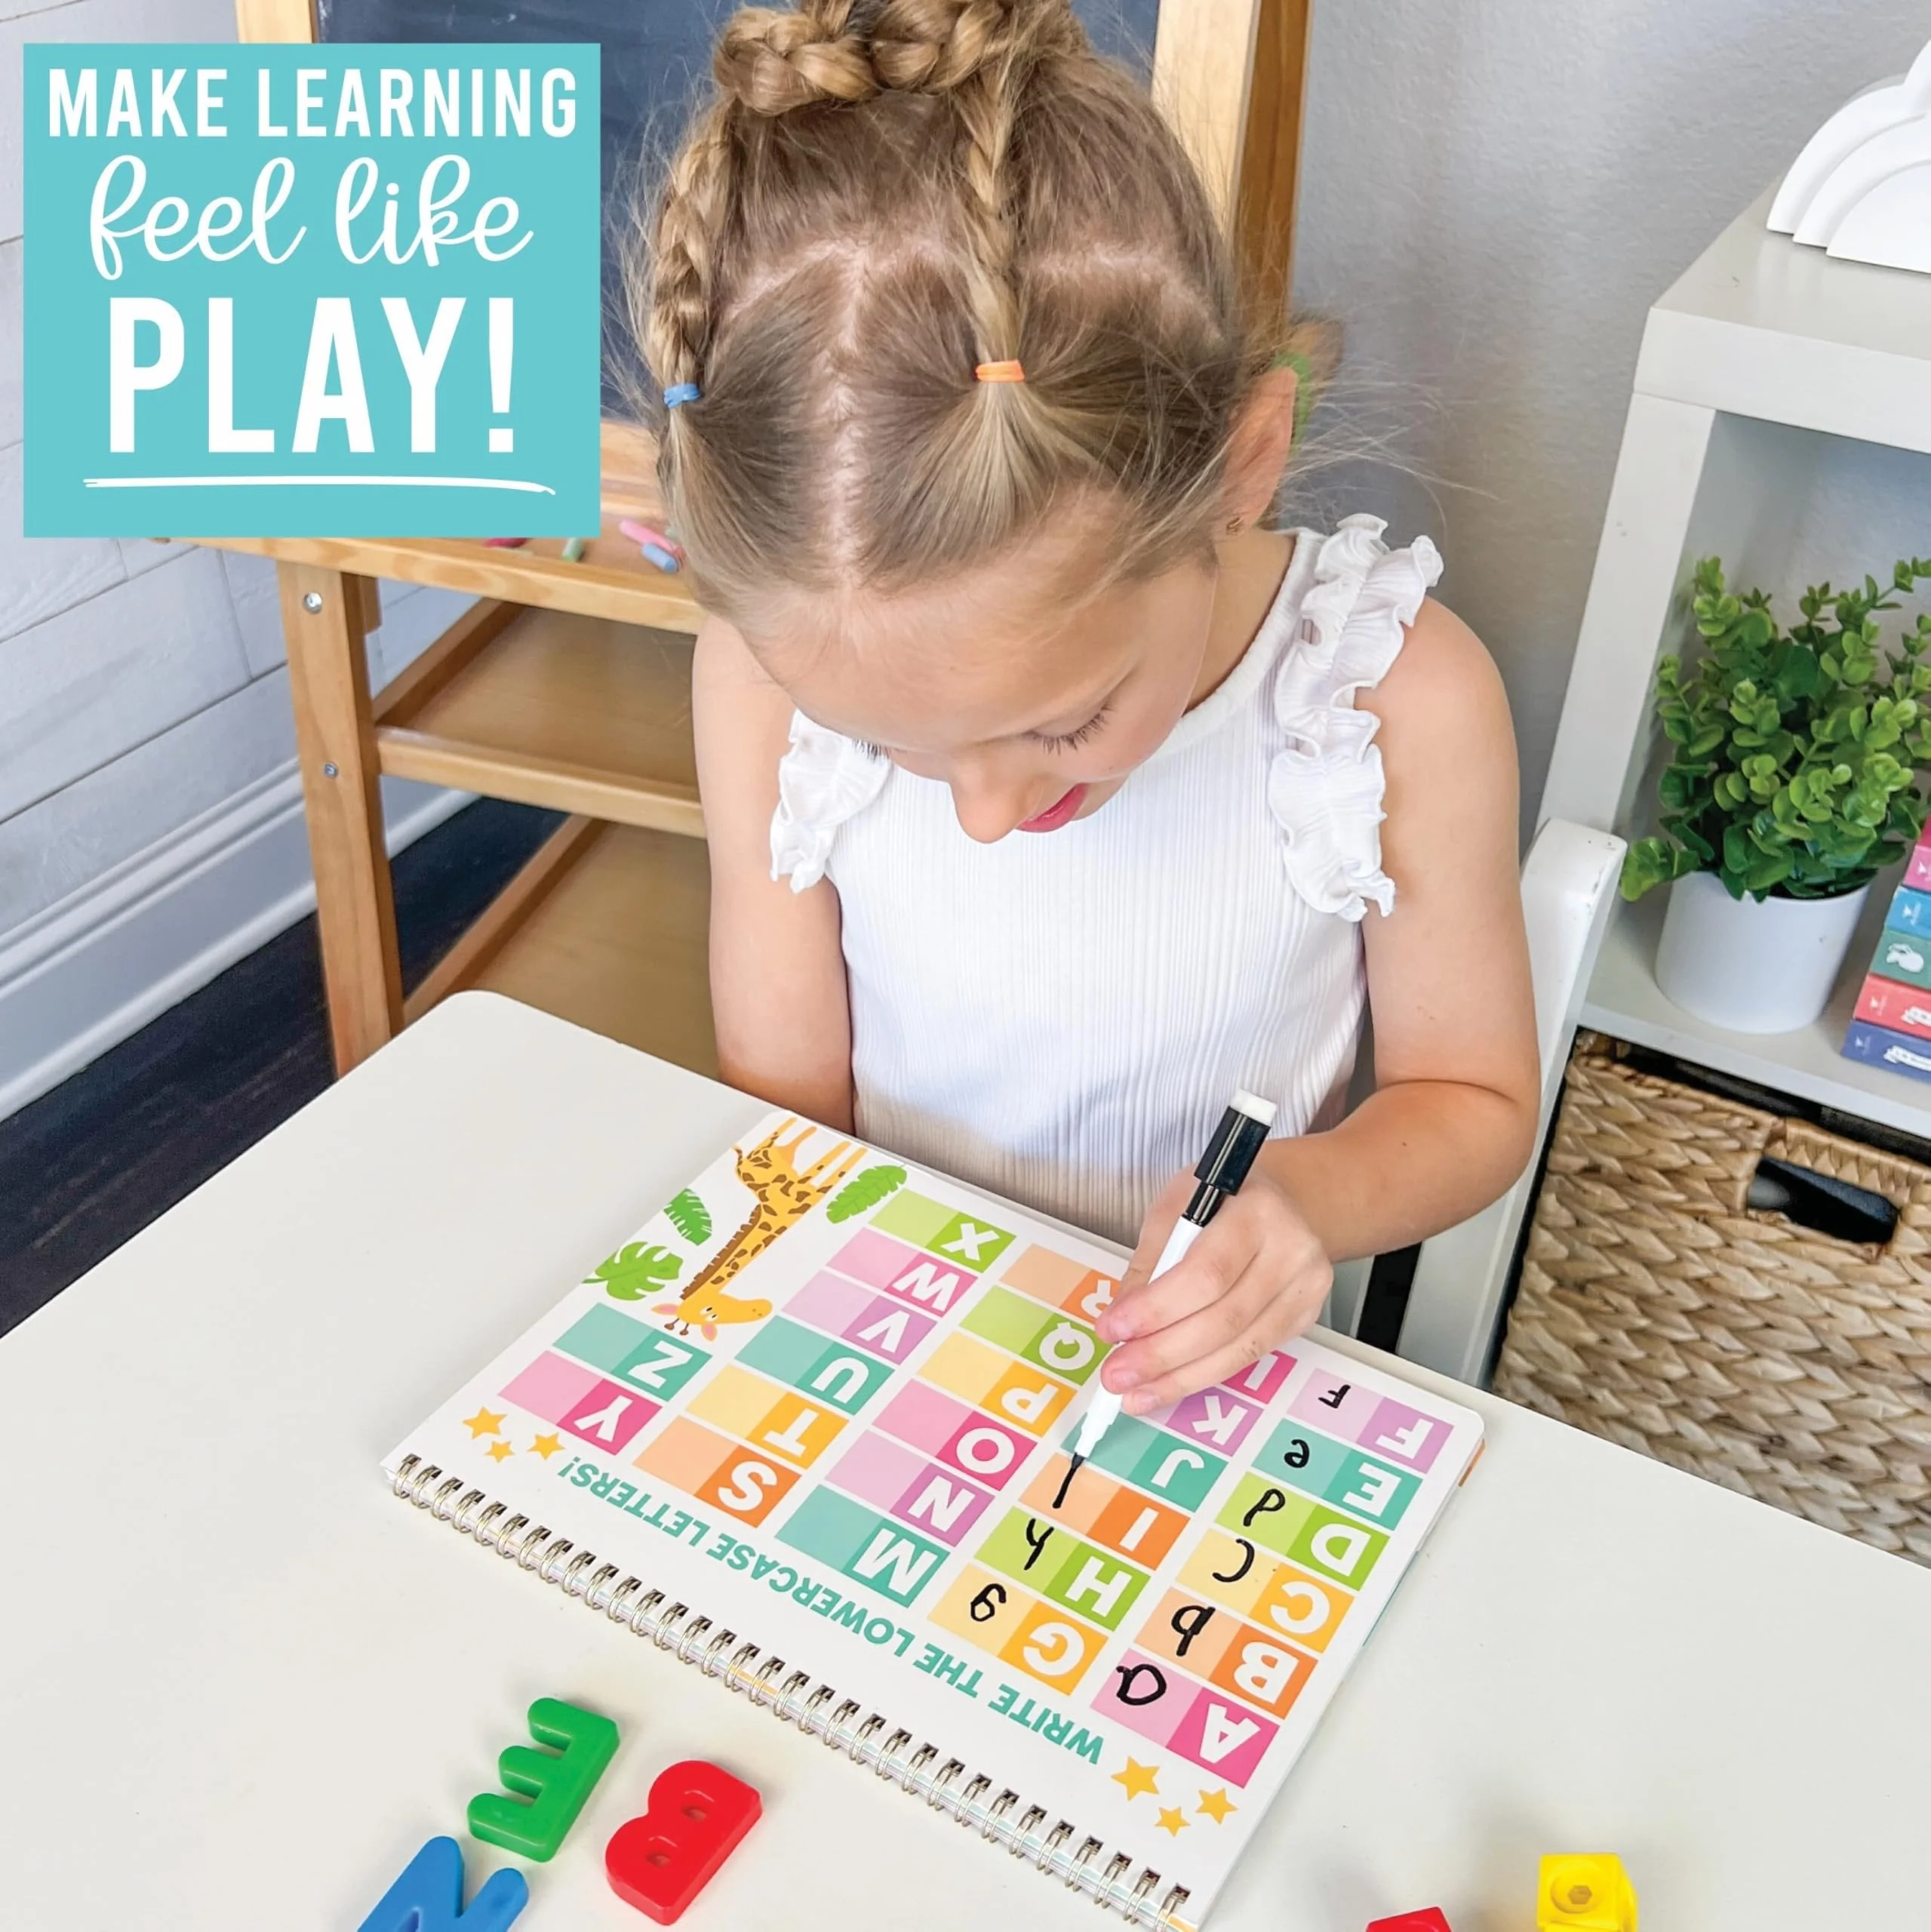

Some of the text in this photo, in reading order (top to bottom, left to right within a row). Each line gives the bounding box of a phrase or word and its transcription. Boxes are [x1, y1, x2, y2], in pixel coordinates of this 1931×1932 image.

[942, 1223, 998, 1261] X
[858, 1311, 910, 1352] V
[1039, 1322, 1094, 1370] Q
[627, 1340, 693, 1389] Z
[810, 1357, 871, 1404] U
[574, 1395, 624, 1441] Y
[1002, 1383, 1057, 1423] P
[1192, 1395, 1249, 1446] K
[763, 1409, 820, 1456] T
[956, 1428, 1015, 1474] O
[1284, 1439, 1310, 1469] e
[1374, 1416, 1430, 1458] F
[718, 1462, 778, 1511] S
[1151, 1448, 1205, 1488] J
[1342, 1463, 1402, 1516] E
[908, 1475, 976, 1533] N
[1024, 1518, 1054, 1571] h
[1120, 1507, 1158, 1552] I
[1311, 1524, 1371, 1576] D
[853, 1528, 942, 1596] M
[1065, 1555, 1132, 1616] H
[557, 1456, 1102, 1764] WRITE THE LOWERCASE LETTERS!
[1171, 1605, 1216, 1657] b
[1270, 1583, 1330, 1634] C
[1023, 1624, 1084, 1675] G
[1234, 1643, 1299, 1703] B
[1116, 1664, 1167, 1706] a
[1199, 1703, 1260, 1764] A
[604, 1760, 763, 1926] B
